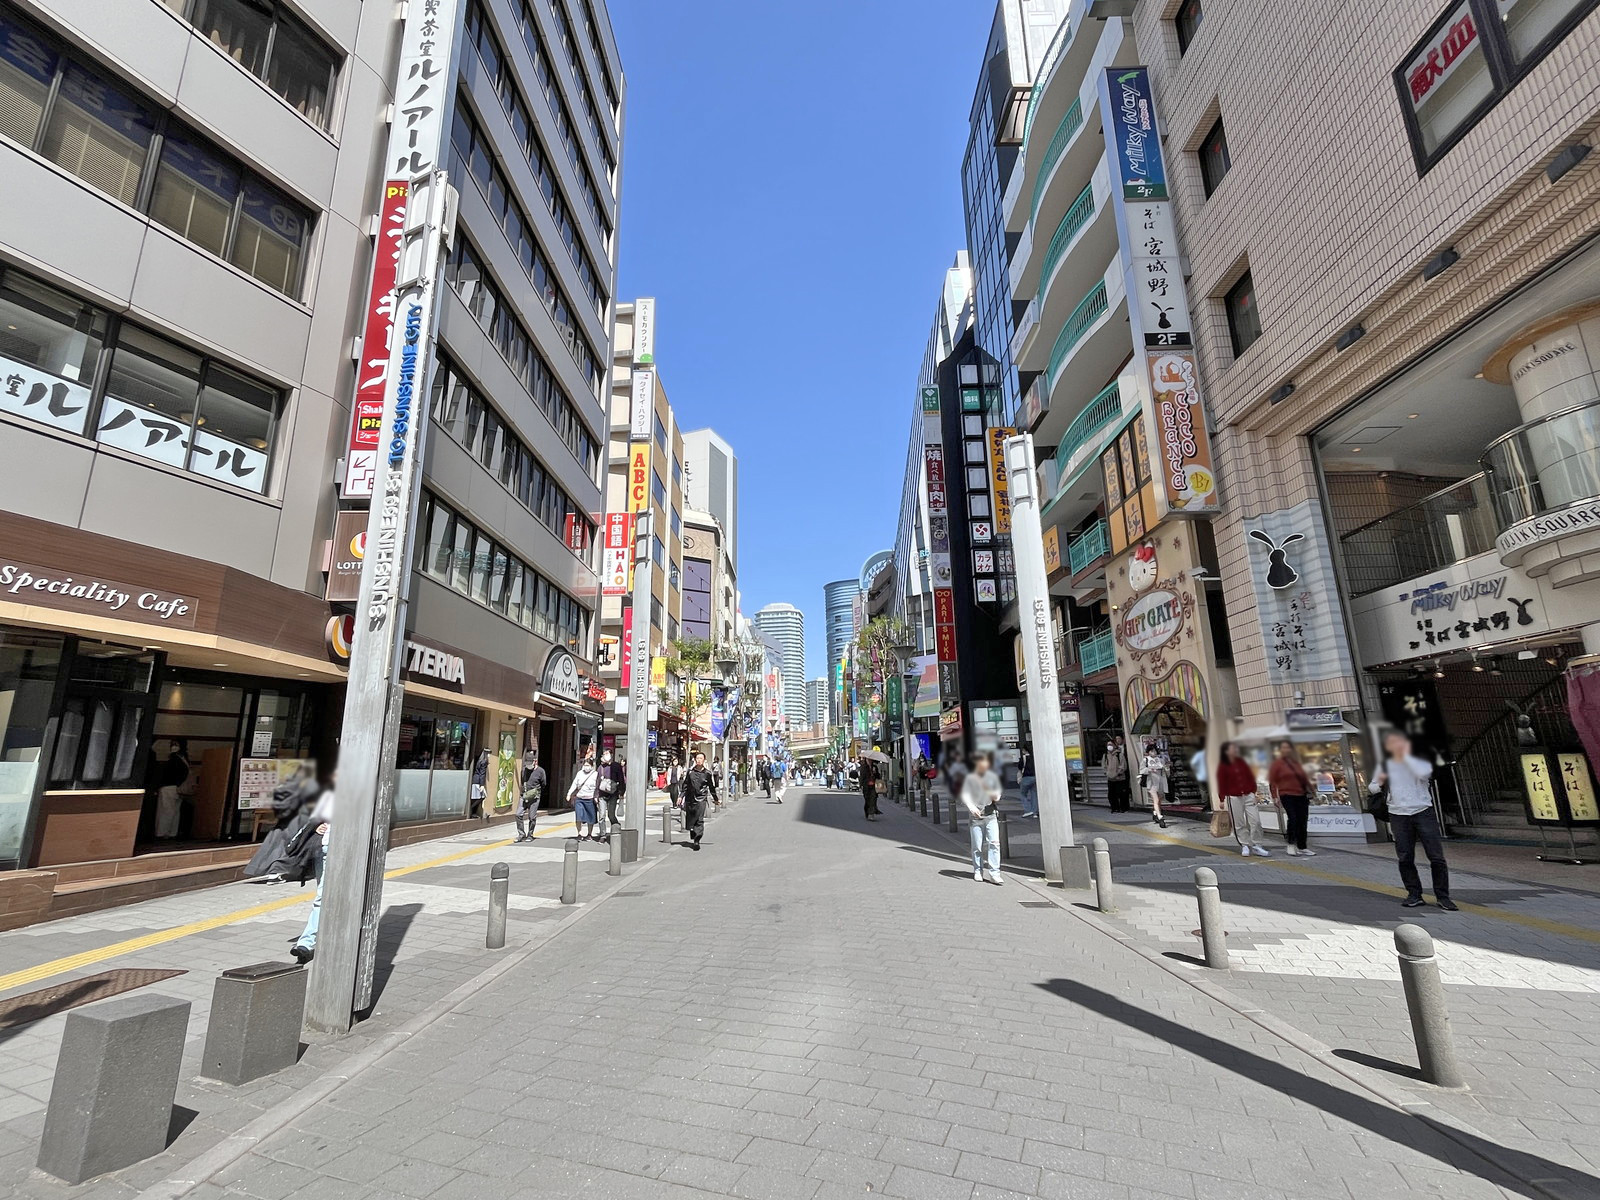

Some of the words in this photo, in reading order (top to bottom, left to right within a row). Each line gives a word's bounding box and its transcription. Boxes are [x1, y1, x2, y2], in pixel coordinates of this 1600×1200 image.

[1121, 84, 1141, 124] Way
[1128, 124, 1147, 176] Milky
[1137, 186, 1153, 198] 2F
[1144, 236, 1169, 297] 宮城野
[404, 302, 422, 342] CITY
[1157, 333, 1177, 345] 2F
[392, 342, 418, 435] SUNSHINE
[0, 373, 256, 478] 室ルノアール
[611, 514, 623, 547] 中国語
[368, 516, 398, 618] SUNSHINE
[977, 554, 991, 563] カラ
[0, 564, 130, 611] Speciality
[137, 591, 189, 617] Cafe
[1411, 591, 1460, 615] Milky
[1460, 576, 1508, 601] Way
[1124, 612, 1146, 638] GIFT
[1147, 596, 1181, 628] GATE
[1038, 626, 1052, 683] SUNSHINE
[636, 662, 646, 706] SUNSHINE
[1531, 763, 1545, 791] そば
[1564, 761, 1580, 791] そば
